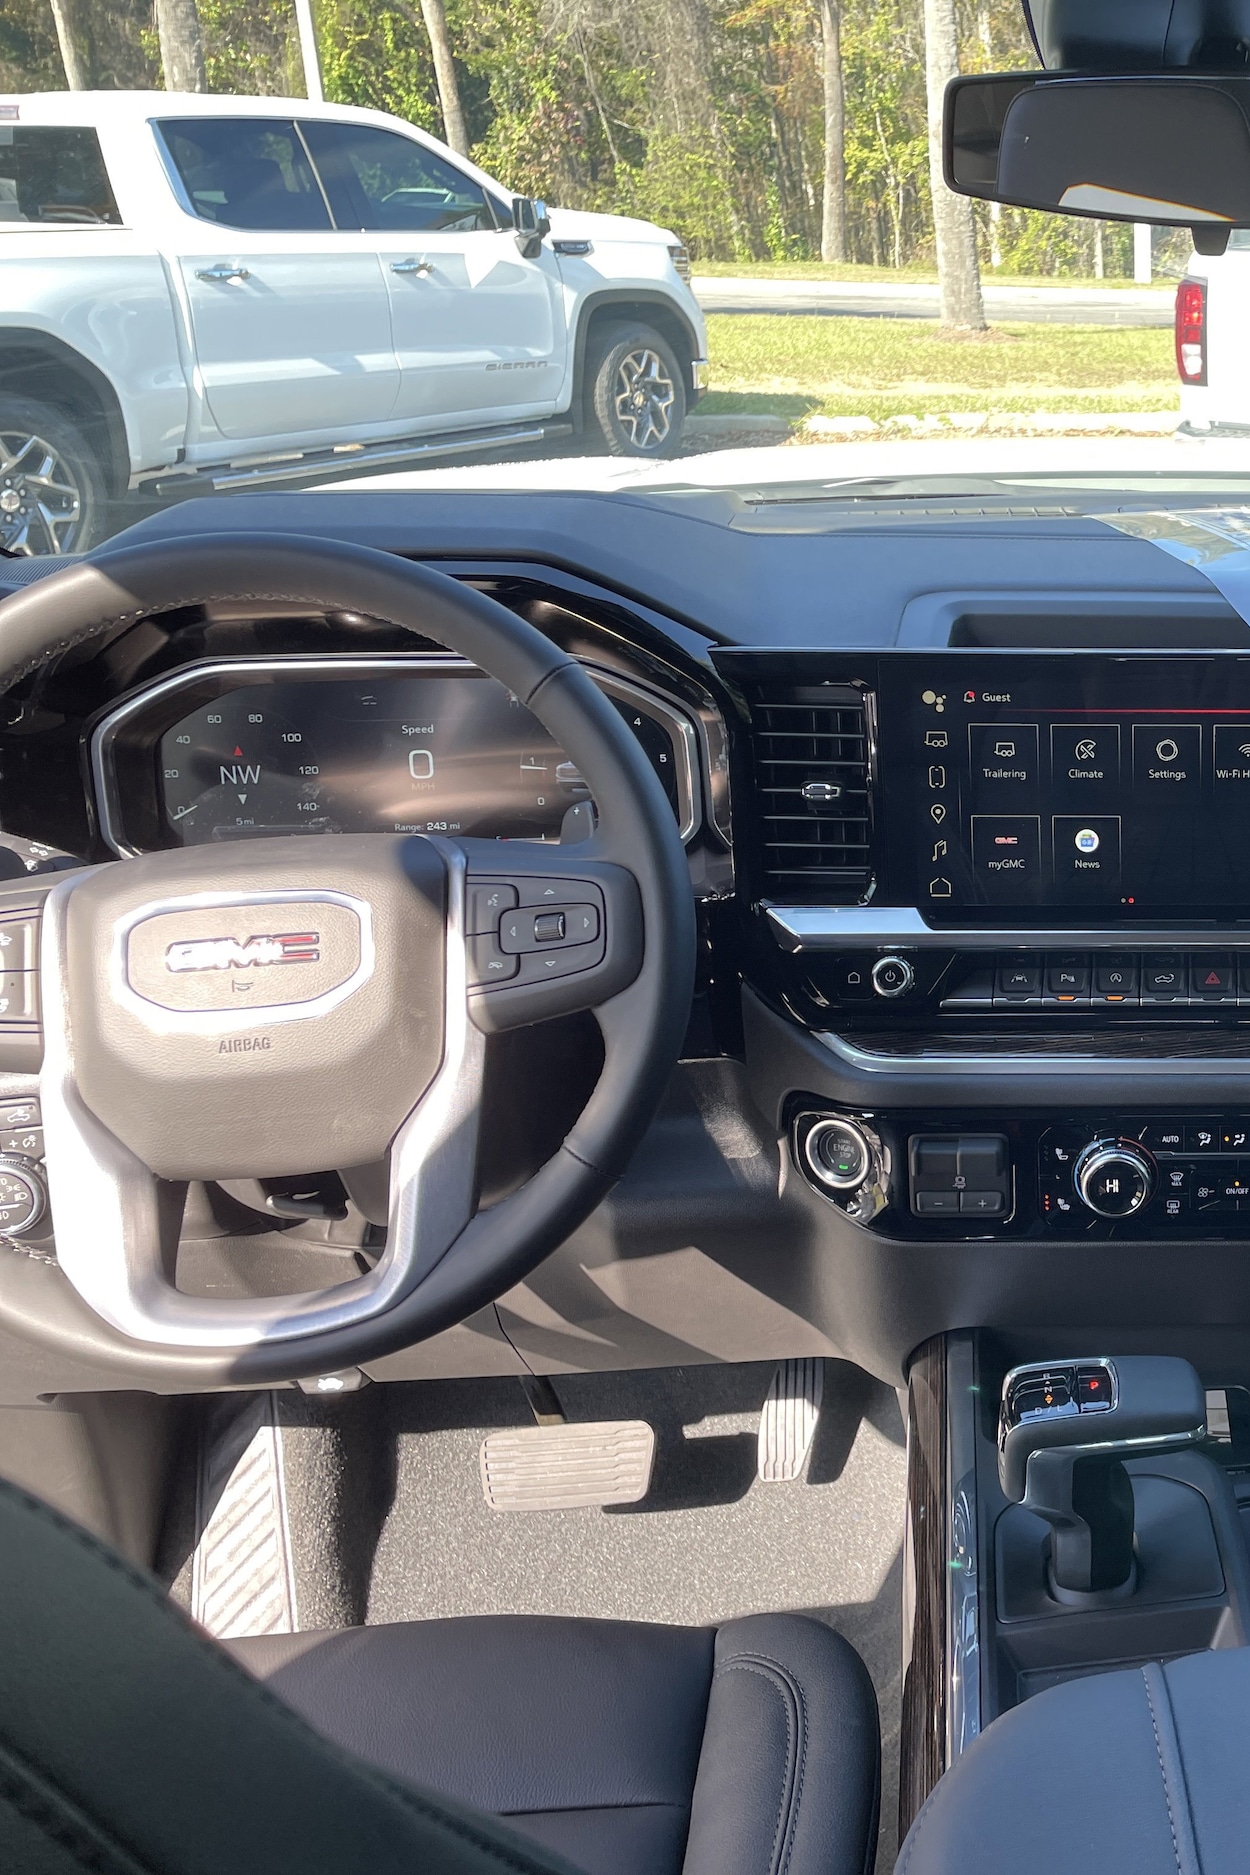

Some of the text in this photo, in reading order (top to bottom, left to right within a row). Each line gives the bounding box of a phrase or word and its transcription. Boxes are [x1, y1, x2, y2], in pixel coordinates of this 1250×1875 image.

[981, 692, 1012, 703] Guest
[207, 714, 222, 724] 60
[248, 714, 263, 723] 80
[633, 717, 642, 726] 4
[401, 724, 435, 736] Speed
[175, 735, 191, 744] 40
[281, 733, 302, 743] 100
[659, 753, 667, 763] 5
[408, 749, 435, 780] 0
[164, 769, 179, 778] 20
[219, 765, 261, 785] NW
[299, 766, 320, 775] 120
[982, 768, 1027, 780] Trailering
[1068, 768, 1104, 779] Climate
[1148, 769, 1187, 781] Settings
[1216, 769, 1241, 779] Wi-Fi
[411, 783, 436, 791] MPH
[537, 797, 545, 805] 0
[297, 802, 317, 811] 140
[394, 821, 461, 833] Range: 243 mi
[994, 837, 1018, 845] GMC
[988, 859, 1026, 870] myGMC
[1074, 859, 1101, 869] News
[165, 932, 320, 973] GMC
[218, 1037, 271, 1054] AIRBAG
[1106, 1179, 1119, 1193] HI
[1225, 1187, 1250, 1195] ON/OFF
[1044, 1386, 1053, 1394] N
[1090, 1380, 1099, 1390] P
[1034, 1406, 1043, 1415] D
